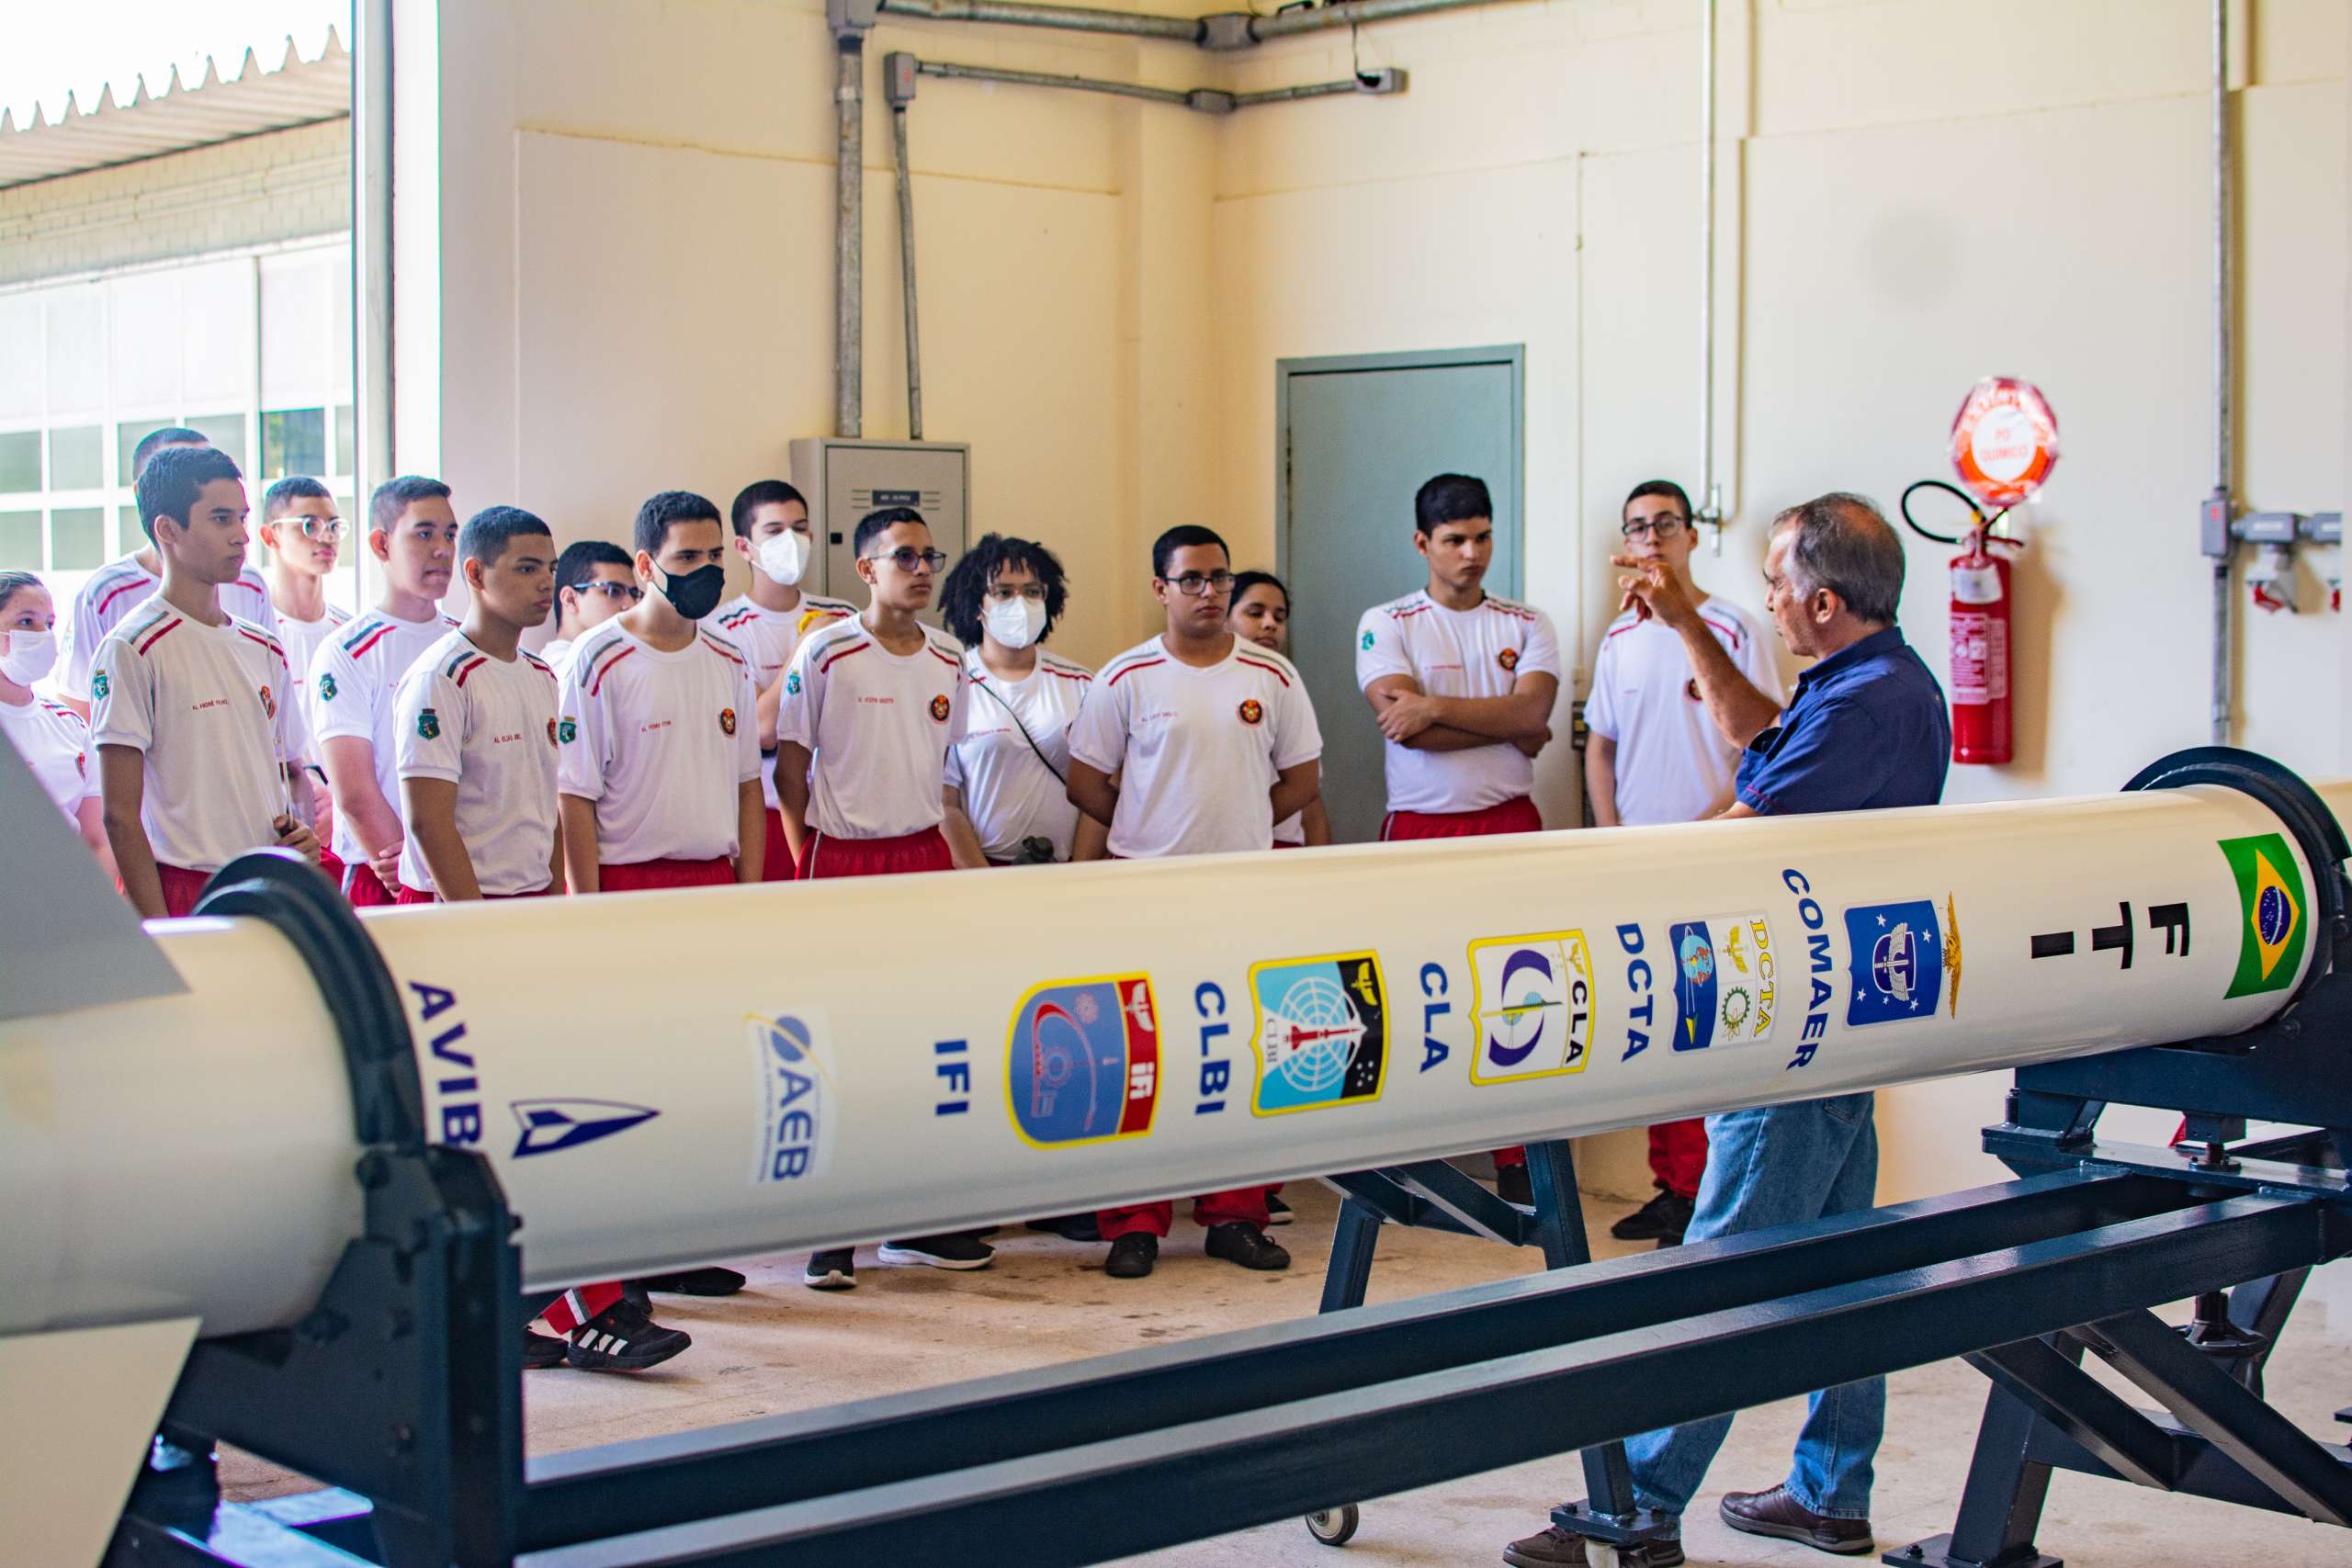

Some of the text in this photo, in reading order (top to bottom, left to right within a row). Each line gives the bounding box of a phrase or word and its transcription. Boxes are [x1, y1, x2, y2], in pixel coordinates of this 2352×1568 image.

[1419, 962, 1451, 1074] CLA
[1565, 979, 1589, 1065] CLA
[1615, 922, 1653, 1062] DCTA
[1748, 919, 1774, 1039] DCTA
[1781, 868, 1832, 1071] COMAER
[933, 1039, 969, 1117] IFI
[1194, 981, 1230, 1115] CLBI
[773, 1067, 812, 1181] AEB
